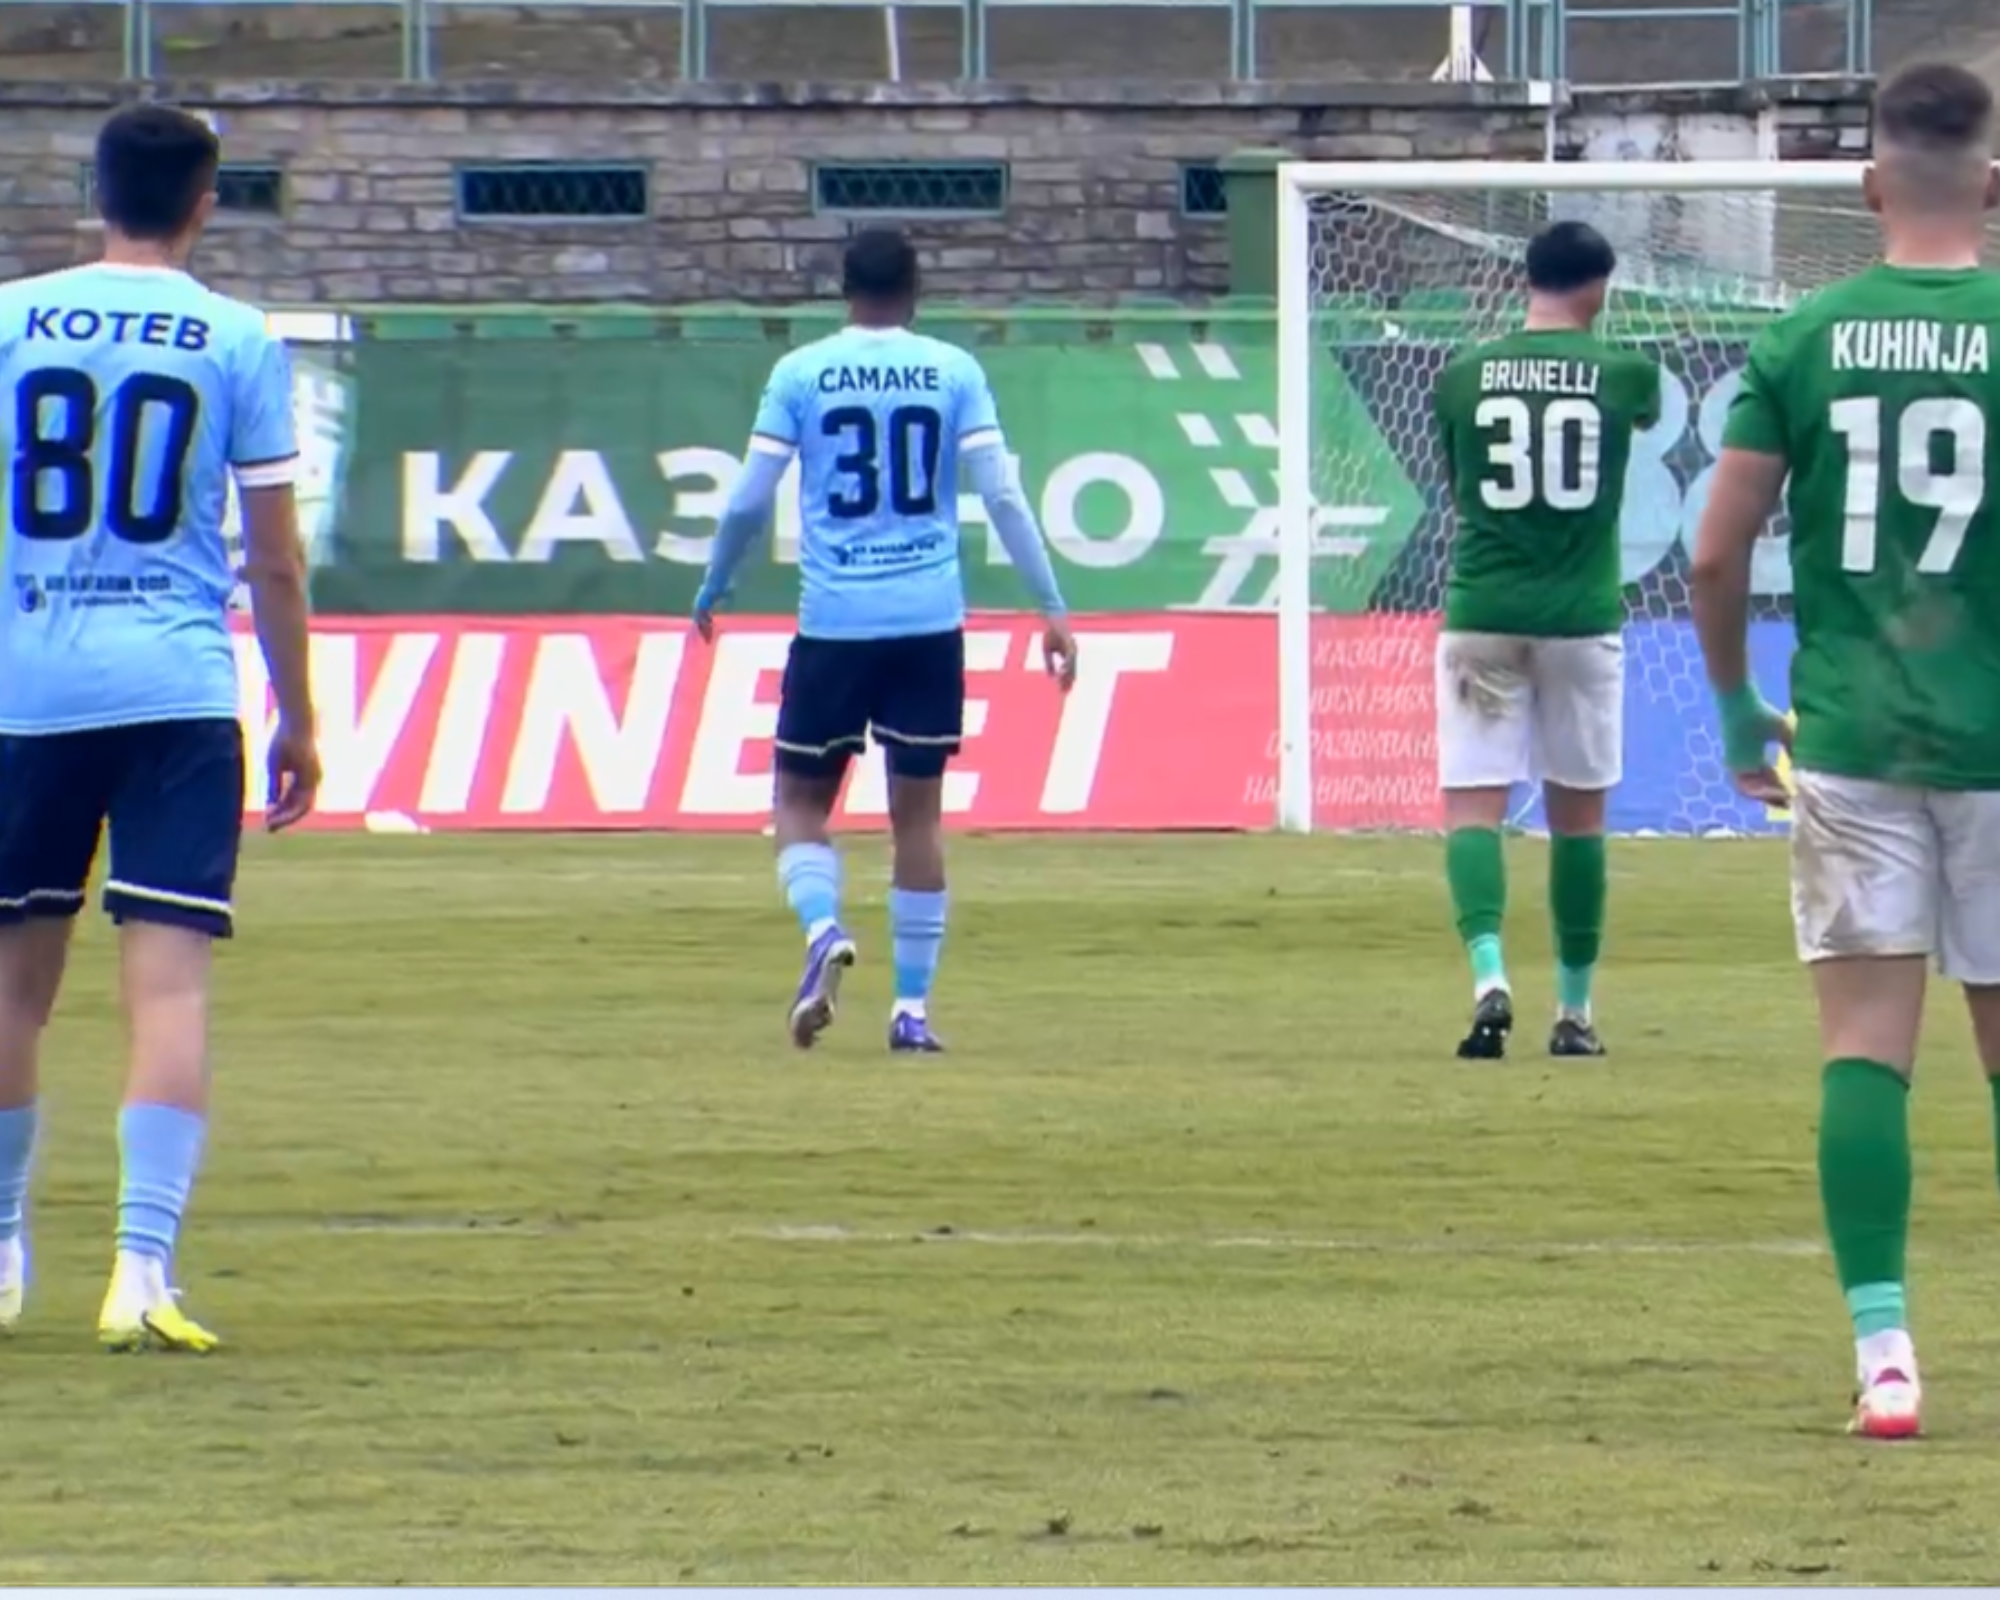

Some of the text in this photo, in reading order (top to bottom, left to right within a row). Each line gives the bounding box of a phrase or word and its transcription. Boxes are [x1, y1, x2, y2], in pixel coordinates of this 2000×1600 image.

[25, 306, 211, 351] КОТЕВ
[818, 366, 940, 393] САМАКЕ
[1479, 359, 1600, 396] BRUNELLI
[1831, 320, 1989, 373] KUHINJA
[12, 366, 198, 544] 80
[403, 449, 1166, 568] КАЗО
[820, 403, 942, 519] 30
[1475, 396, 1601, 511] 30
[1829, 396, 1985, 574] 19
